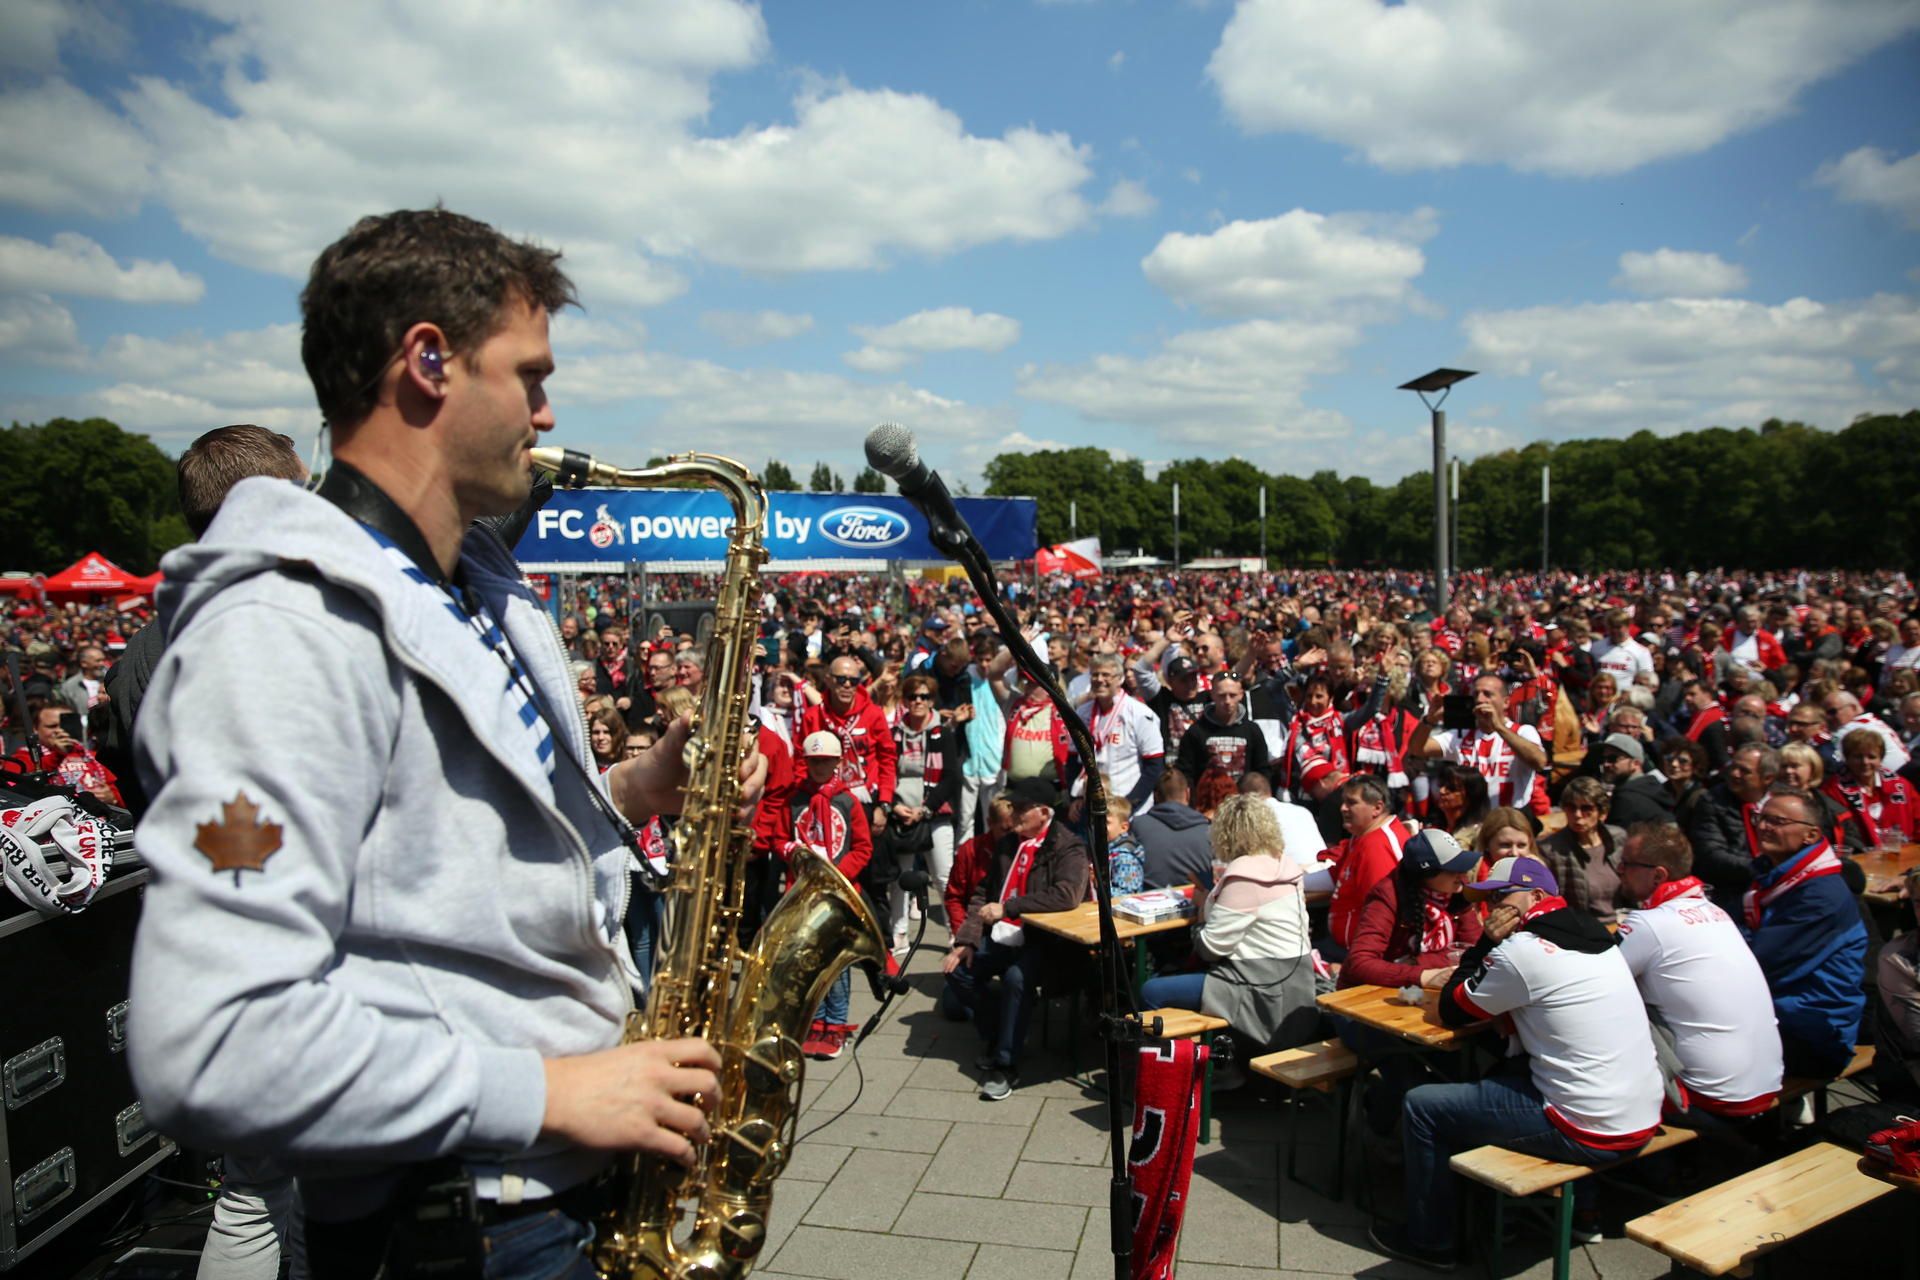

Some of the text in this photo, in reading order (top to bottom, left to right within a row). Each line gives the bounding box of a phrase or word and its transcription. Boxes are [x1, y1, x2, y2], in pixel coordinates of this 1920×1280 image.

[537, 509, 585, 539] FC
[630, 513, 769, 544] power
[775, 511, 812, 543] by
[836, 511, 894, 541] Ford
